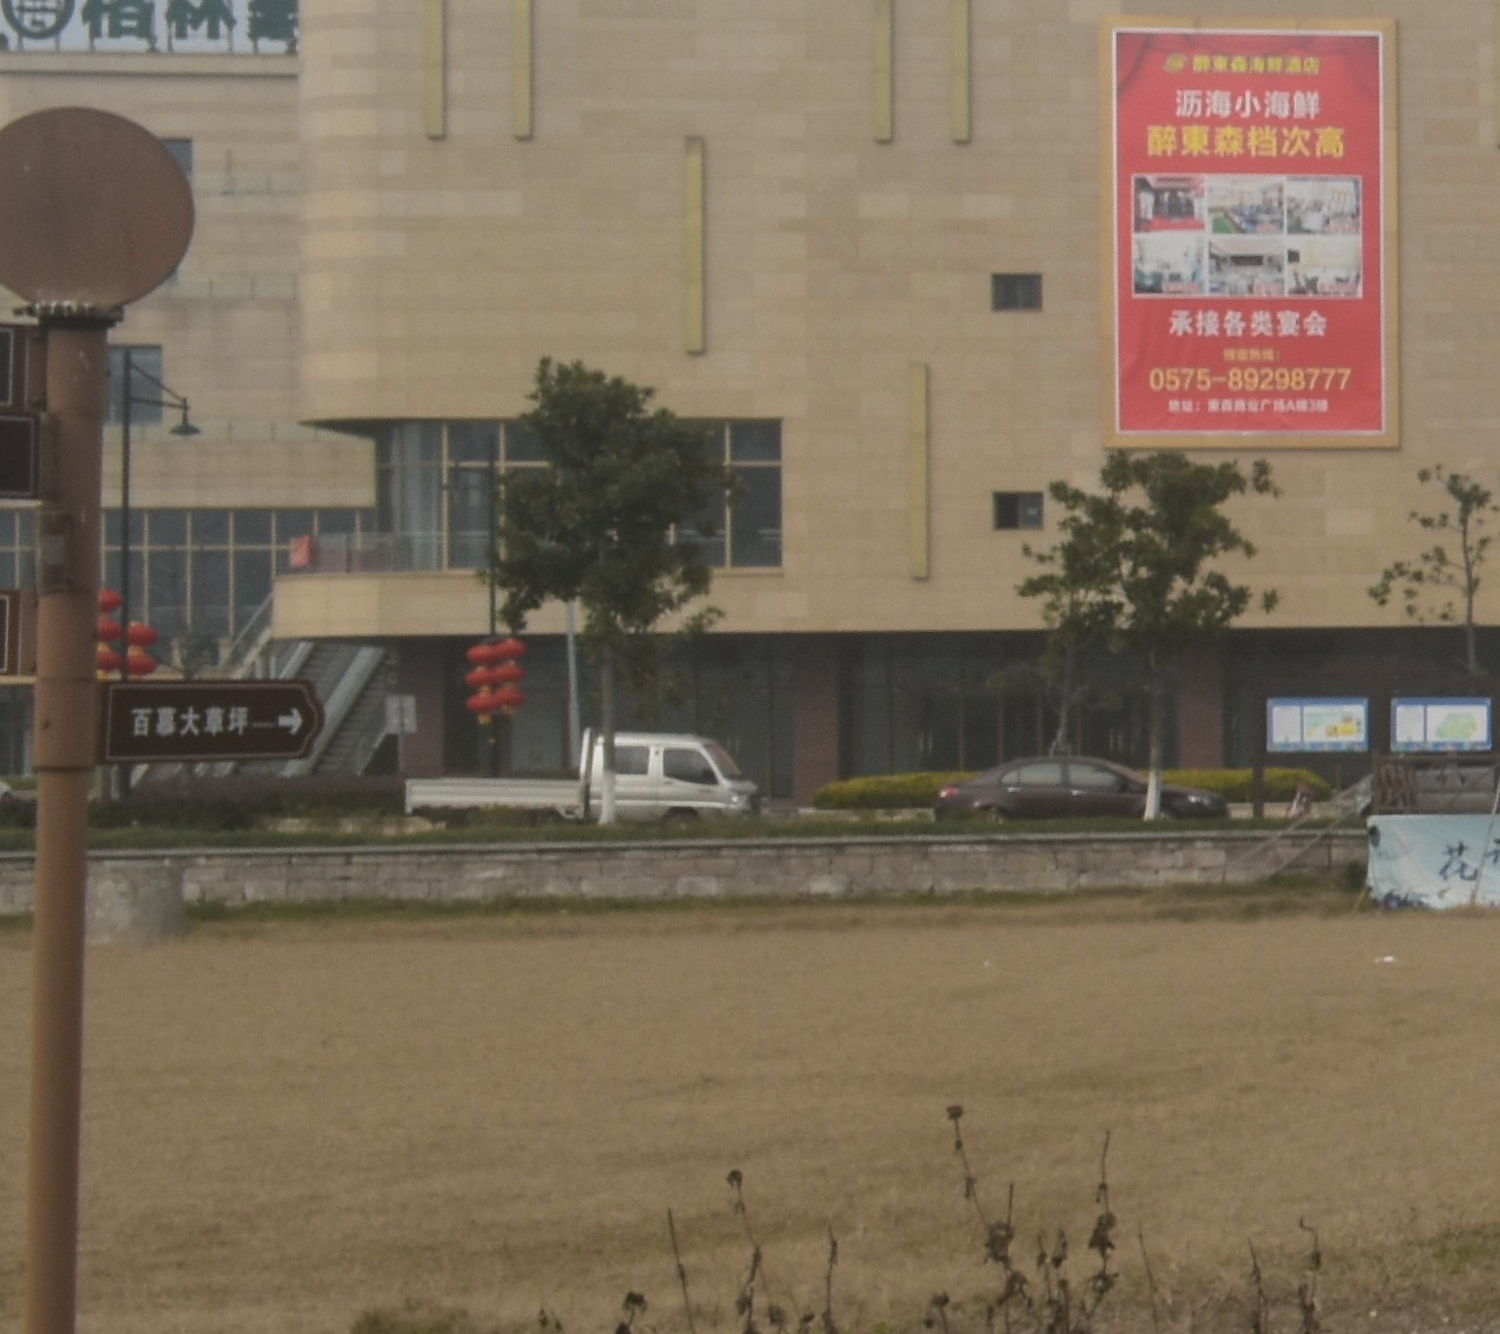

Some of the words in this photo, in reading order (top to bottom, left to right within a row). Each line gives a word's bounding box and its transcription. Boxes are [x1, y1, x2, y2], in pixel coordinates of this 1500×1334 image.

[1176, 90, 1320, 119] 沥海小海鲜
[1169, 310, 1327, 337] 承接各类宴会
[1150, 367, 1351, 391] 0575-89298777
[131, 705, 250, 737] 百慕大草坪
